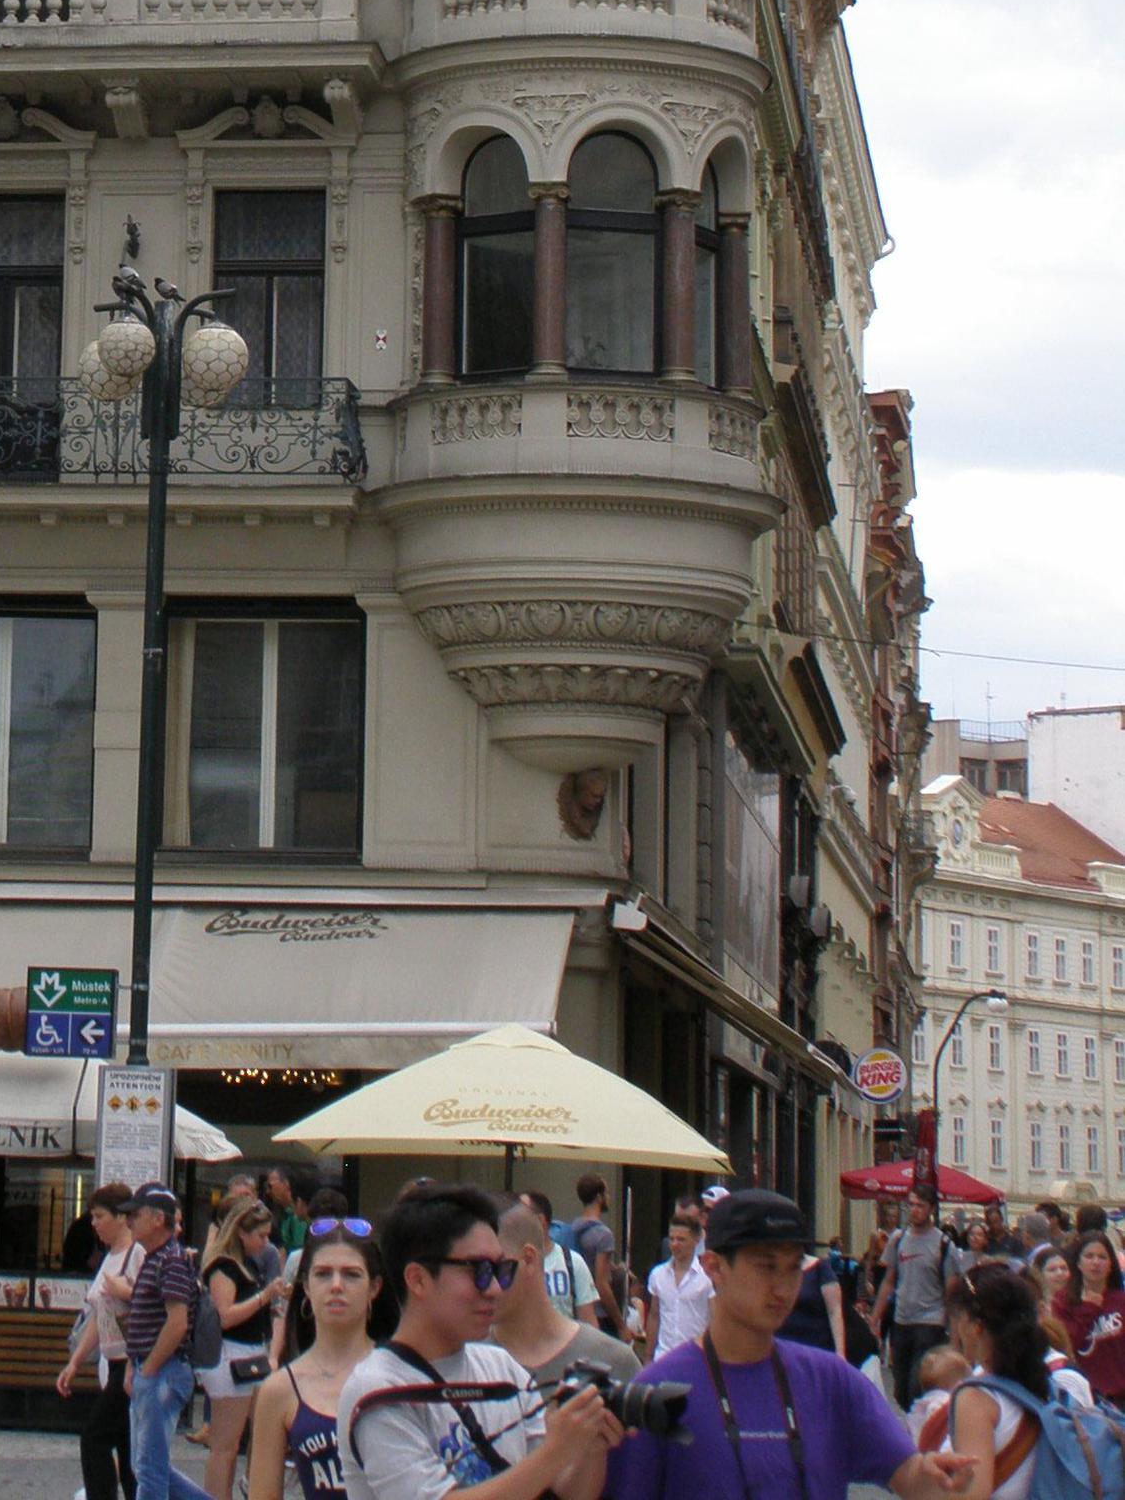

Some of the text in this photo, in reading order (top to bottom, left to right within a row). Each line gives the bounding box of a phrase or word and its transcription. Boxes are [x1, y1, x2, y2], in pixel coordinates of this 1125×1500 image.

[205, 908, 389, 936] Budweiser
[279, 927, 379, 942] Budvar
[859, 1060, 901, 1076] BURGER
[109, 1081, 162, 1092] ATTENTION
[859, 1072, 901, 1088] KING
[423, 1099, 579, 1127] Budweiser
[487, 1118, 570, 1134] Budvar
[442, 1387, 484, 1399] Canon
[298, 1432, 327, 1457] YOU
